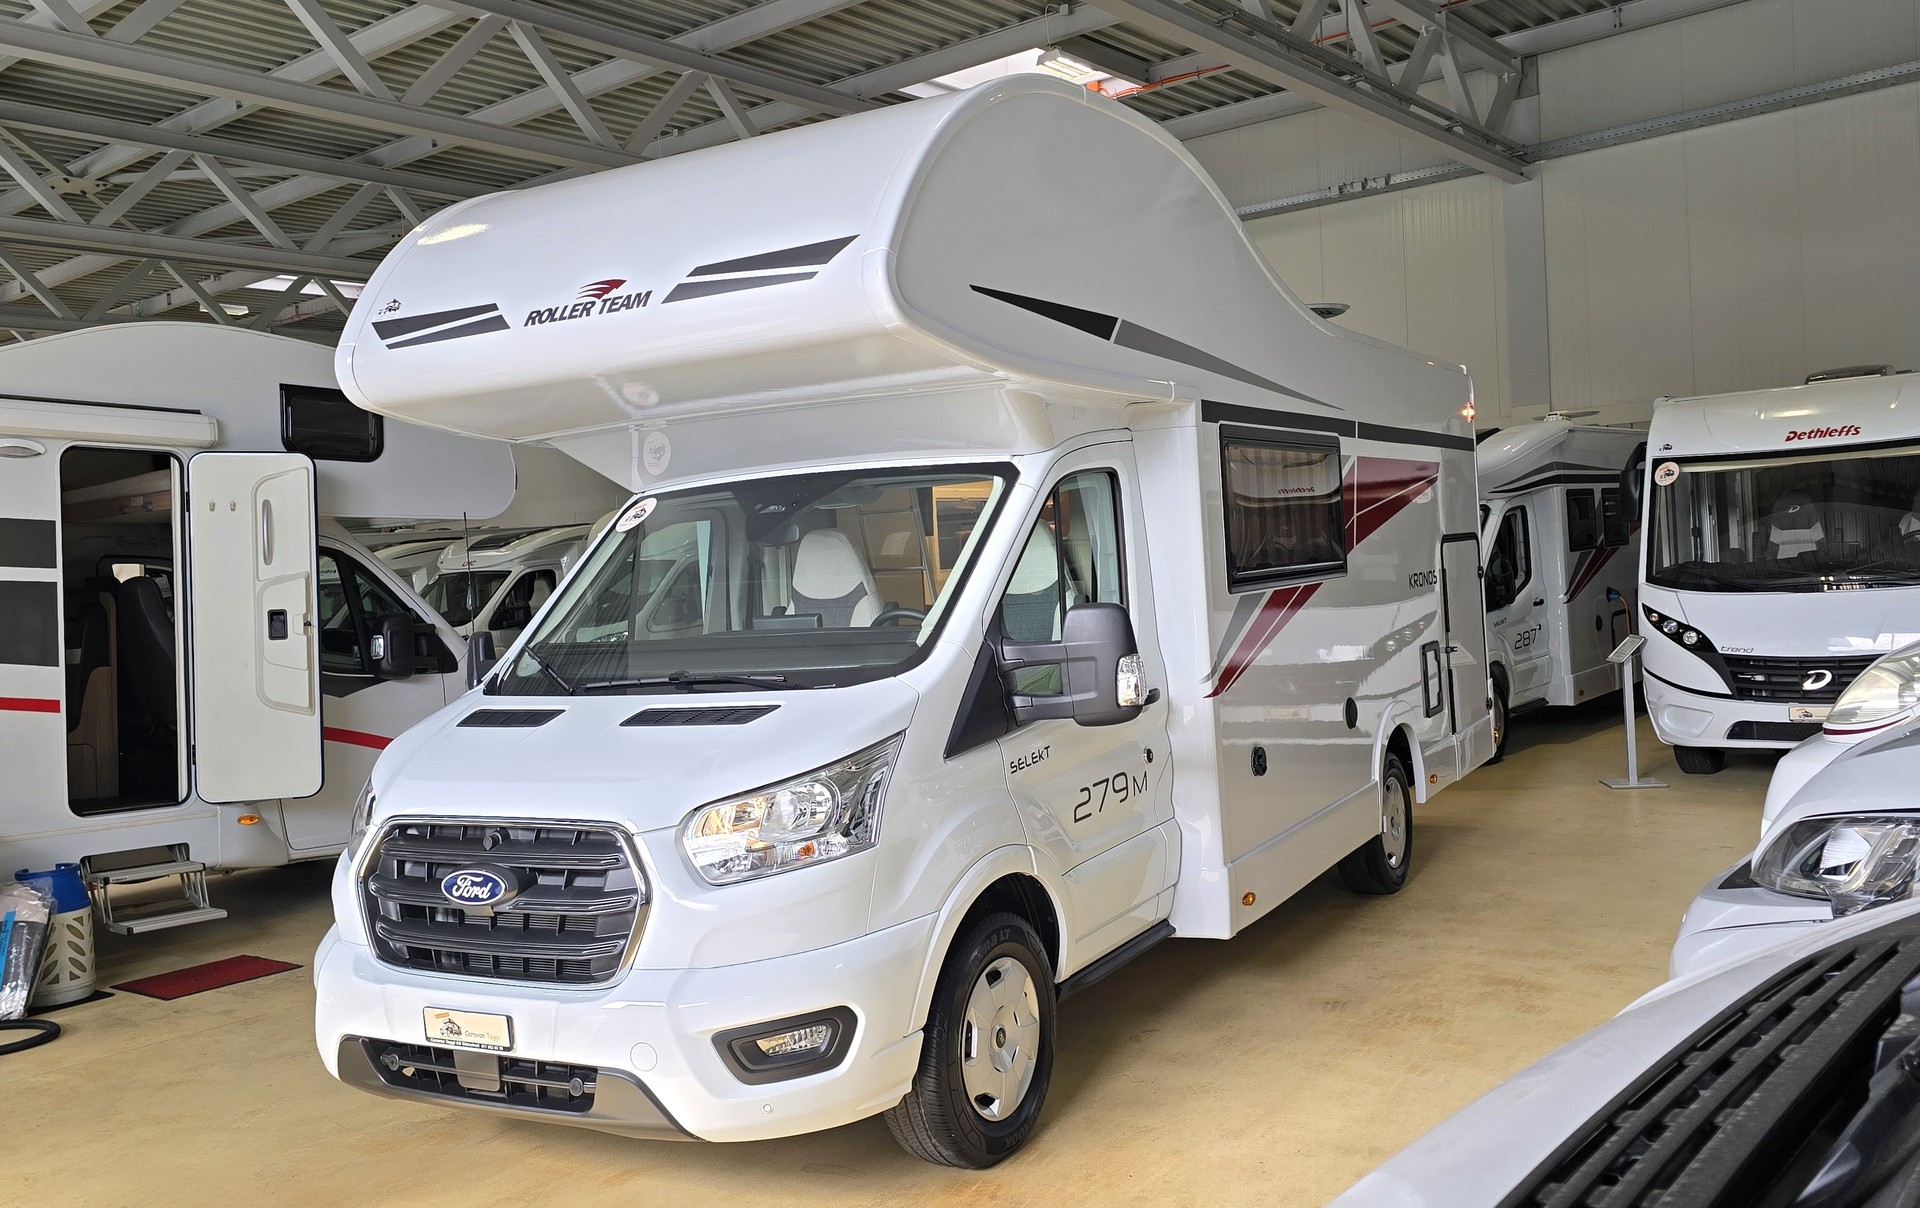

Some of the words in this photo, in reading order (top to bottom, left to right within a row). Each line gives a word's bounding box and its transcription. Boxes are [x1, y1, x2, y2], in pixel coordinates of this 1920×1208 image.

[523, 300, 596, 327] ROLLER
[598, 290, 653, 315] TEAM
[1785, 425, 1861, 442] Dethleffs
[1408, 570, 1438, 589] KRONOS
[1514, 628, 1537, 650] 287
[1720, 645, 1754, 654] trend
[1010, 745, 1051, 774] SELEKT
[452, 874, 493, 899] Ford
